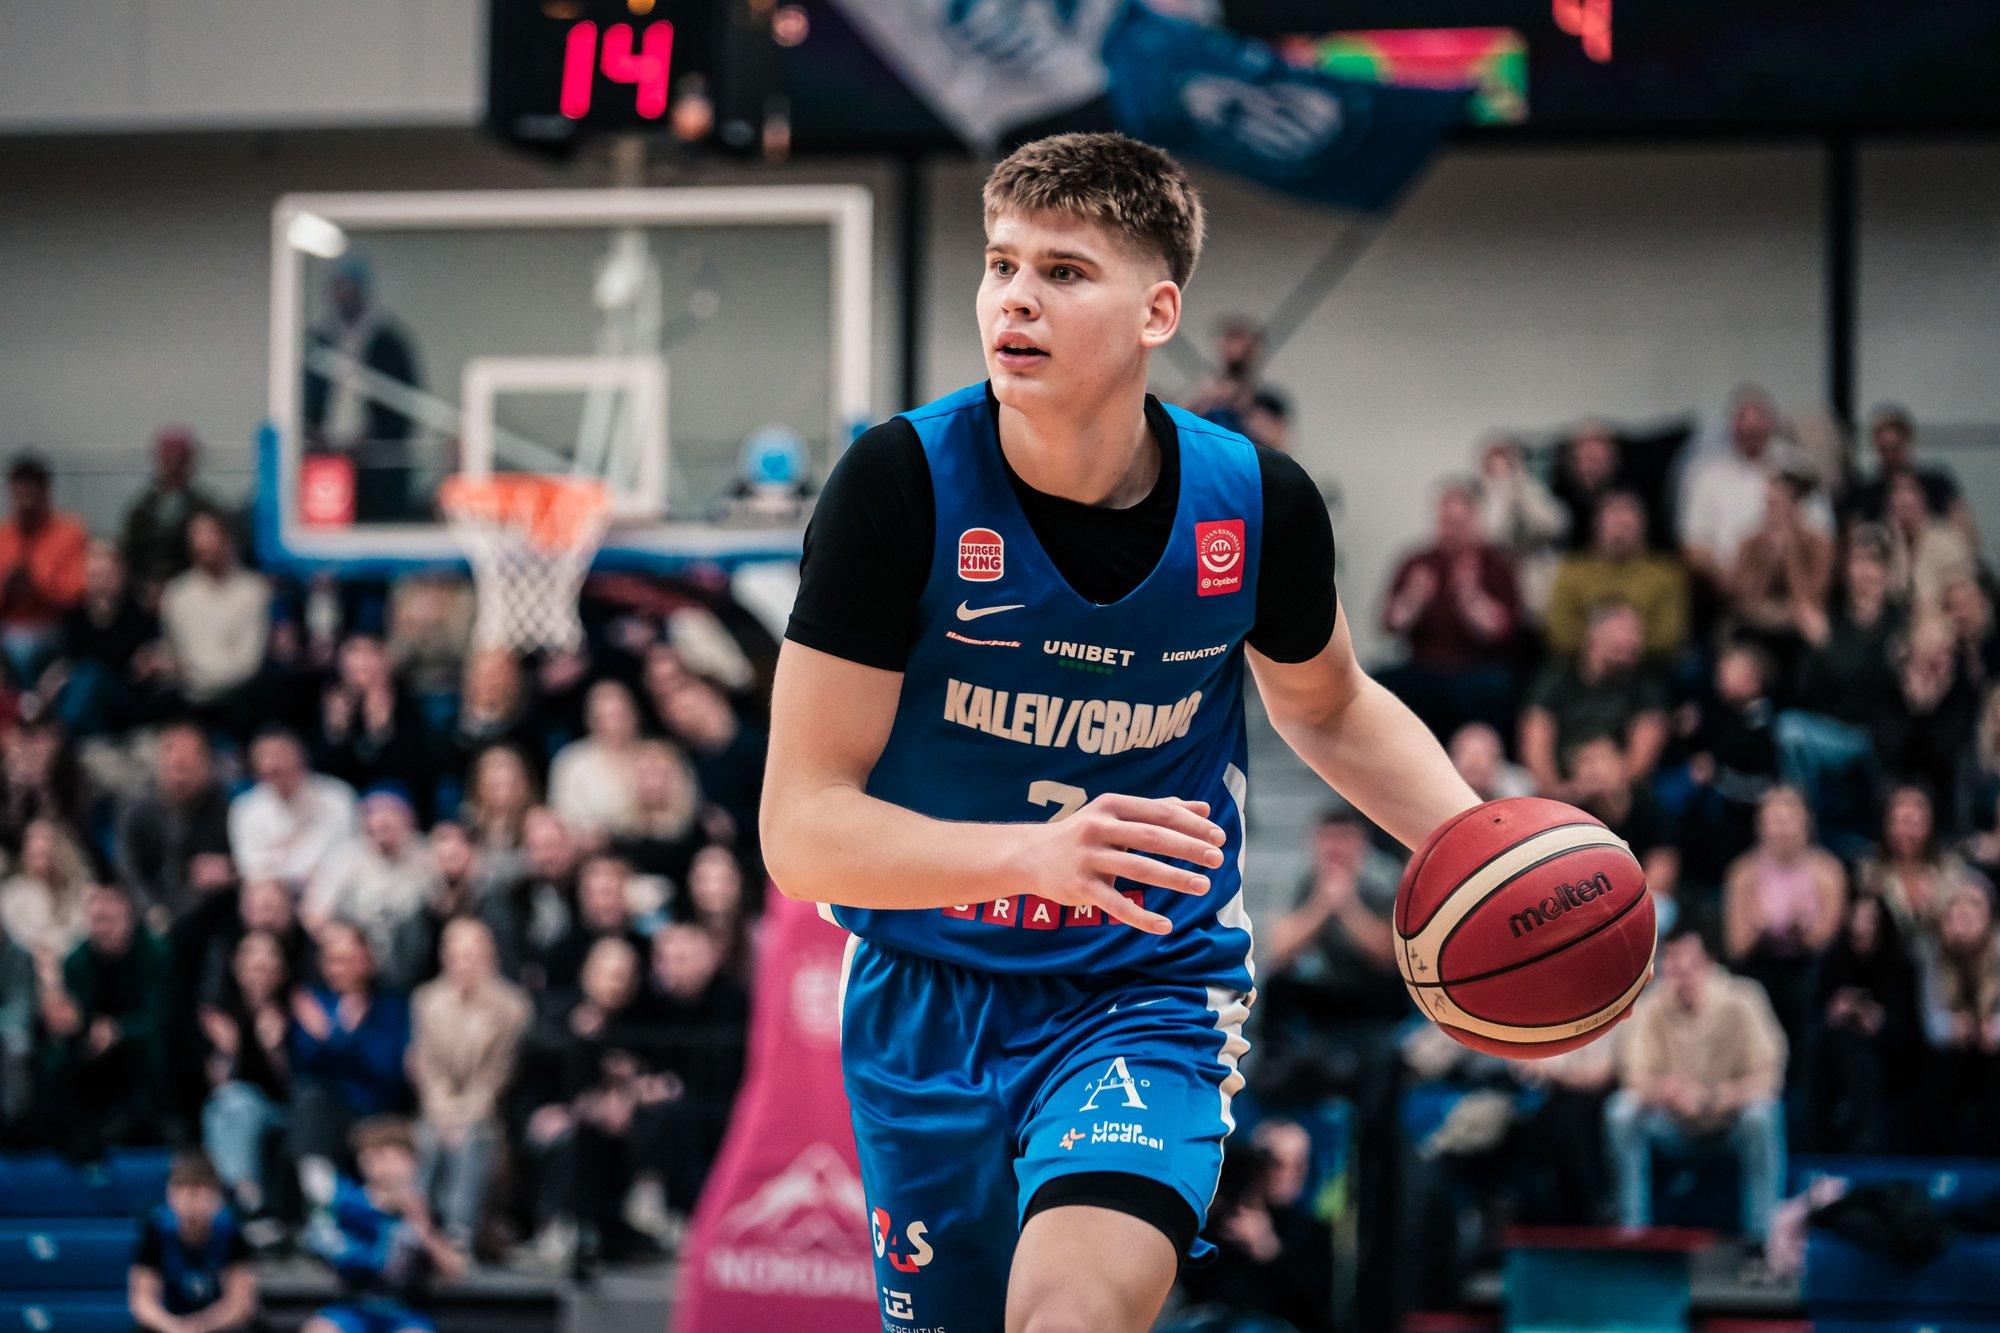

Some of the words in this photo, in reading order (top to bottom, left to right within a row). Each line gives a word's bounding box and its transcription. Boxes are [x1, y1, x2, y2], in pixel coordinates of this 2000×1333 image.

[560, 19, 674, 120] 14
[960, 545, 1001, 556] BURGER
[960, 556, 1001, 570] KING
[1212, 576, 1239, 588] Optibet
[1043, 640, 1135, 667] UNIBET
[1162, 644, 1228, 662] LIGNATOR
[943, 677, 1203, 756] KALEV/CRAMO
[1508, 871, 1613, 938] molten
[1091, 1132, 1164, 1151] Medical
